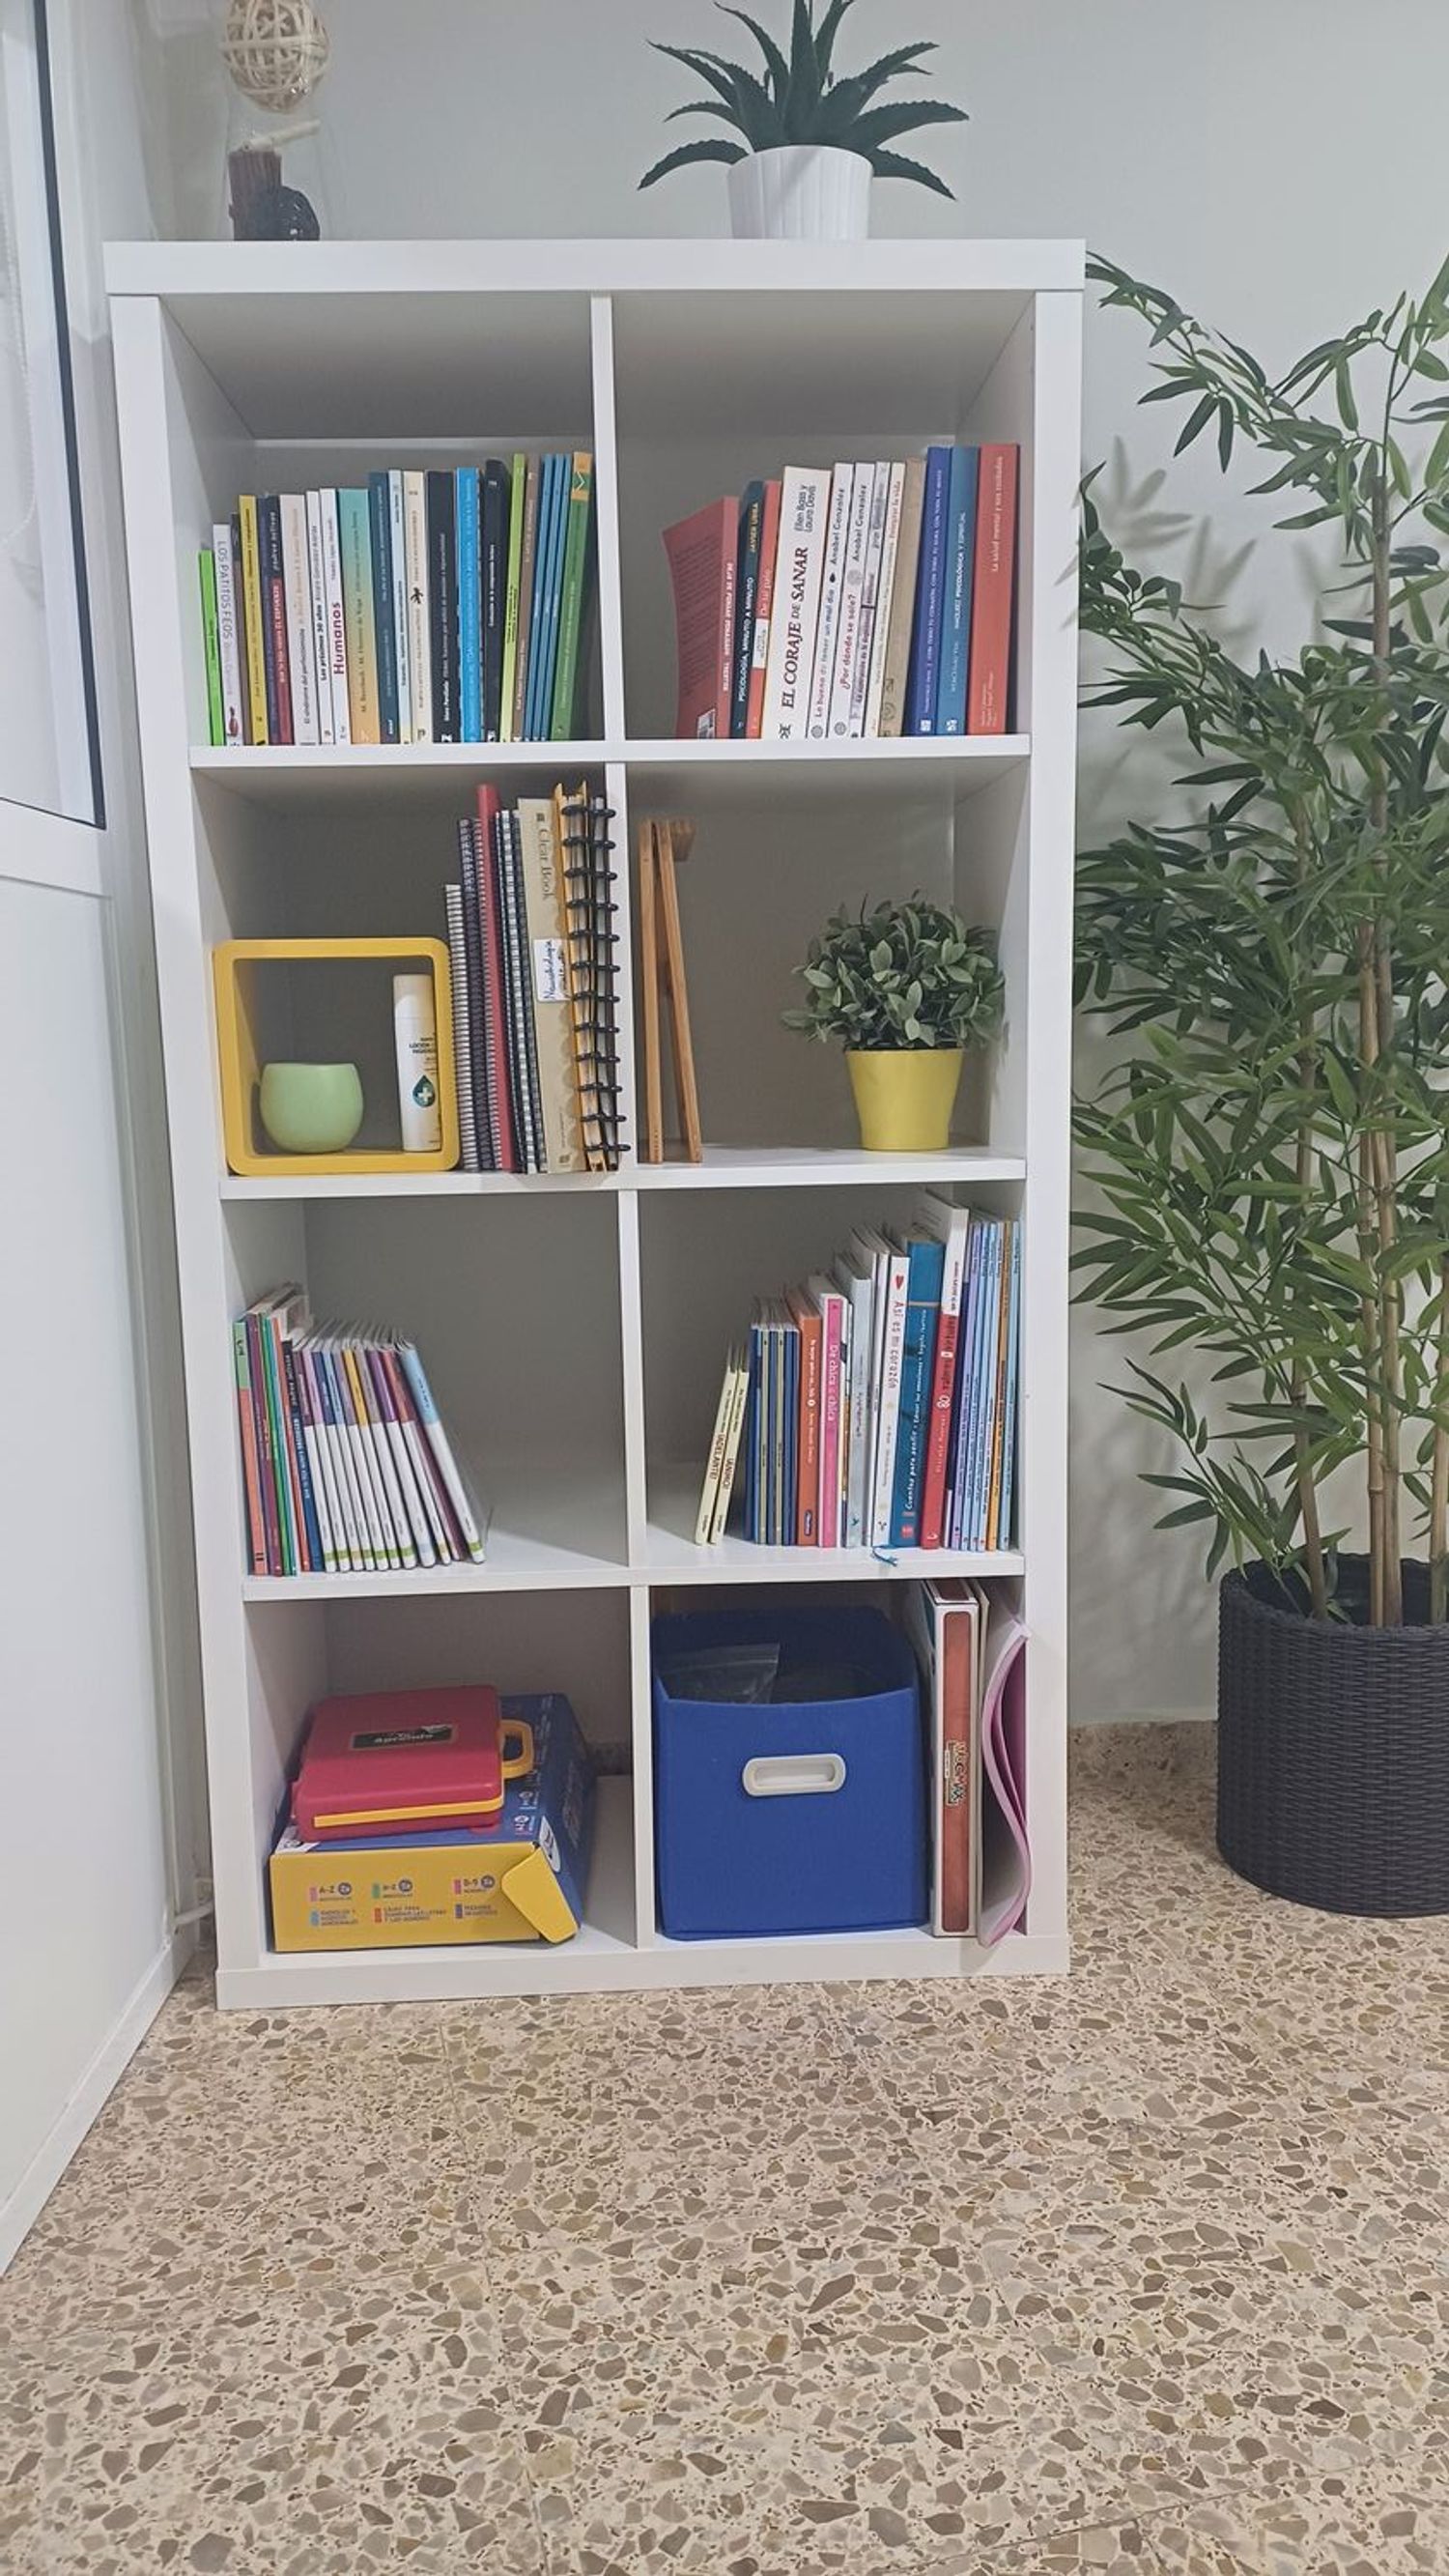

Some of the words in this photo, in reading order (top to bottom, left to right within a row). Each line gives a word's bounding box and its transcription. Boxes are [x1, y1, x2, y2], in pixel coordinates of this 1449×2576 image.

[794, 512, 806, 531] Ellen
[804, 510, 815, 533] Laura
[992, 512, 1001, 539] mental
[216, 541, 228, 562] LOS
[829, 531, 840, 564] Anabel
[851, 529, 864, 562] Anabel
[991, 541, 1001, 562] salud
[792, 547, 809, 602] SANAR
[991, 562, 999, 572] La
[218, 564, 232, 610] PATITOS
[745, 578, 753, 609] MINUTO
[760, 601, 769, 615] De
[790, 603, 802, 618] DE
[824, 605, 834, 622] mal
[846, 593, 858, 620] sale?
[222, 611, 233, 640] FEOS
[317, 622, 325, 632] 30
[740, 618, 752, 651] MINUTO
[825, 624, 831, 636] un
[846, 621, 854, 634] se
[332, 603, 345, 674] Humanos
[782, 622, 802, 685] CORAJE
[815, 676, 825, 705] bueno
[839, 667, 851, 690] ¿Por
[781, 688, 796, 709] EL
[815, 707, 823, 718] Lo
[539, 829, 551, 862] Clear
[541, 866, 554, 901] Book
[893, 1301, 904, 1318] Así
[893, 1322, 900, 1333] es
[829, 1344, 839, 1359] De
[891, 1335, 900, 1347] mi
[828, 1360, 838, 1386] chica
[889, 1349, 899, 1389] corazón
[827, 1395, 838, 1421] chica
[909, 1430, 919, 1455] sentir
[908, 1457, 918, 1476] para
[904, 1478, 916, 1509] Cuentos
